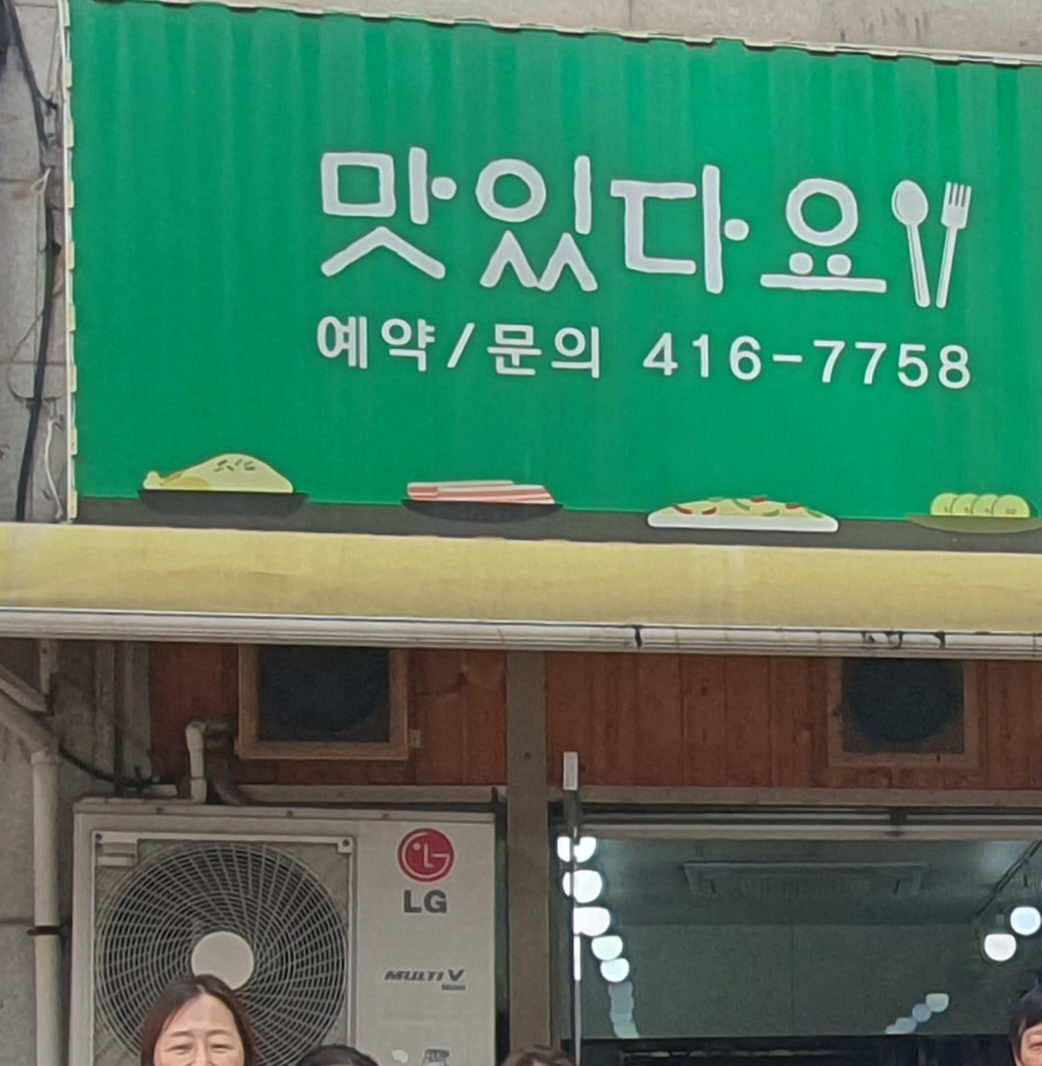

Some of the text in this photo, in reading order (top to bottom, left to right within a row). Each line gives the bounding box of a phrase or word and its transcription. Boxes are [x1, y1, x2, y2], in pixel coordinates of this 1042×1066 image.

[319, 145, 889, 296] 맛있다요
[316, 315, 972, 391] 예약/문의 416-7758
[403, 889, 447, 914] LG
[384, 969, 465, 982] MULTI V
